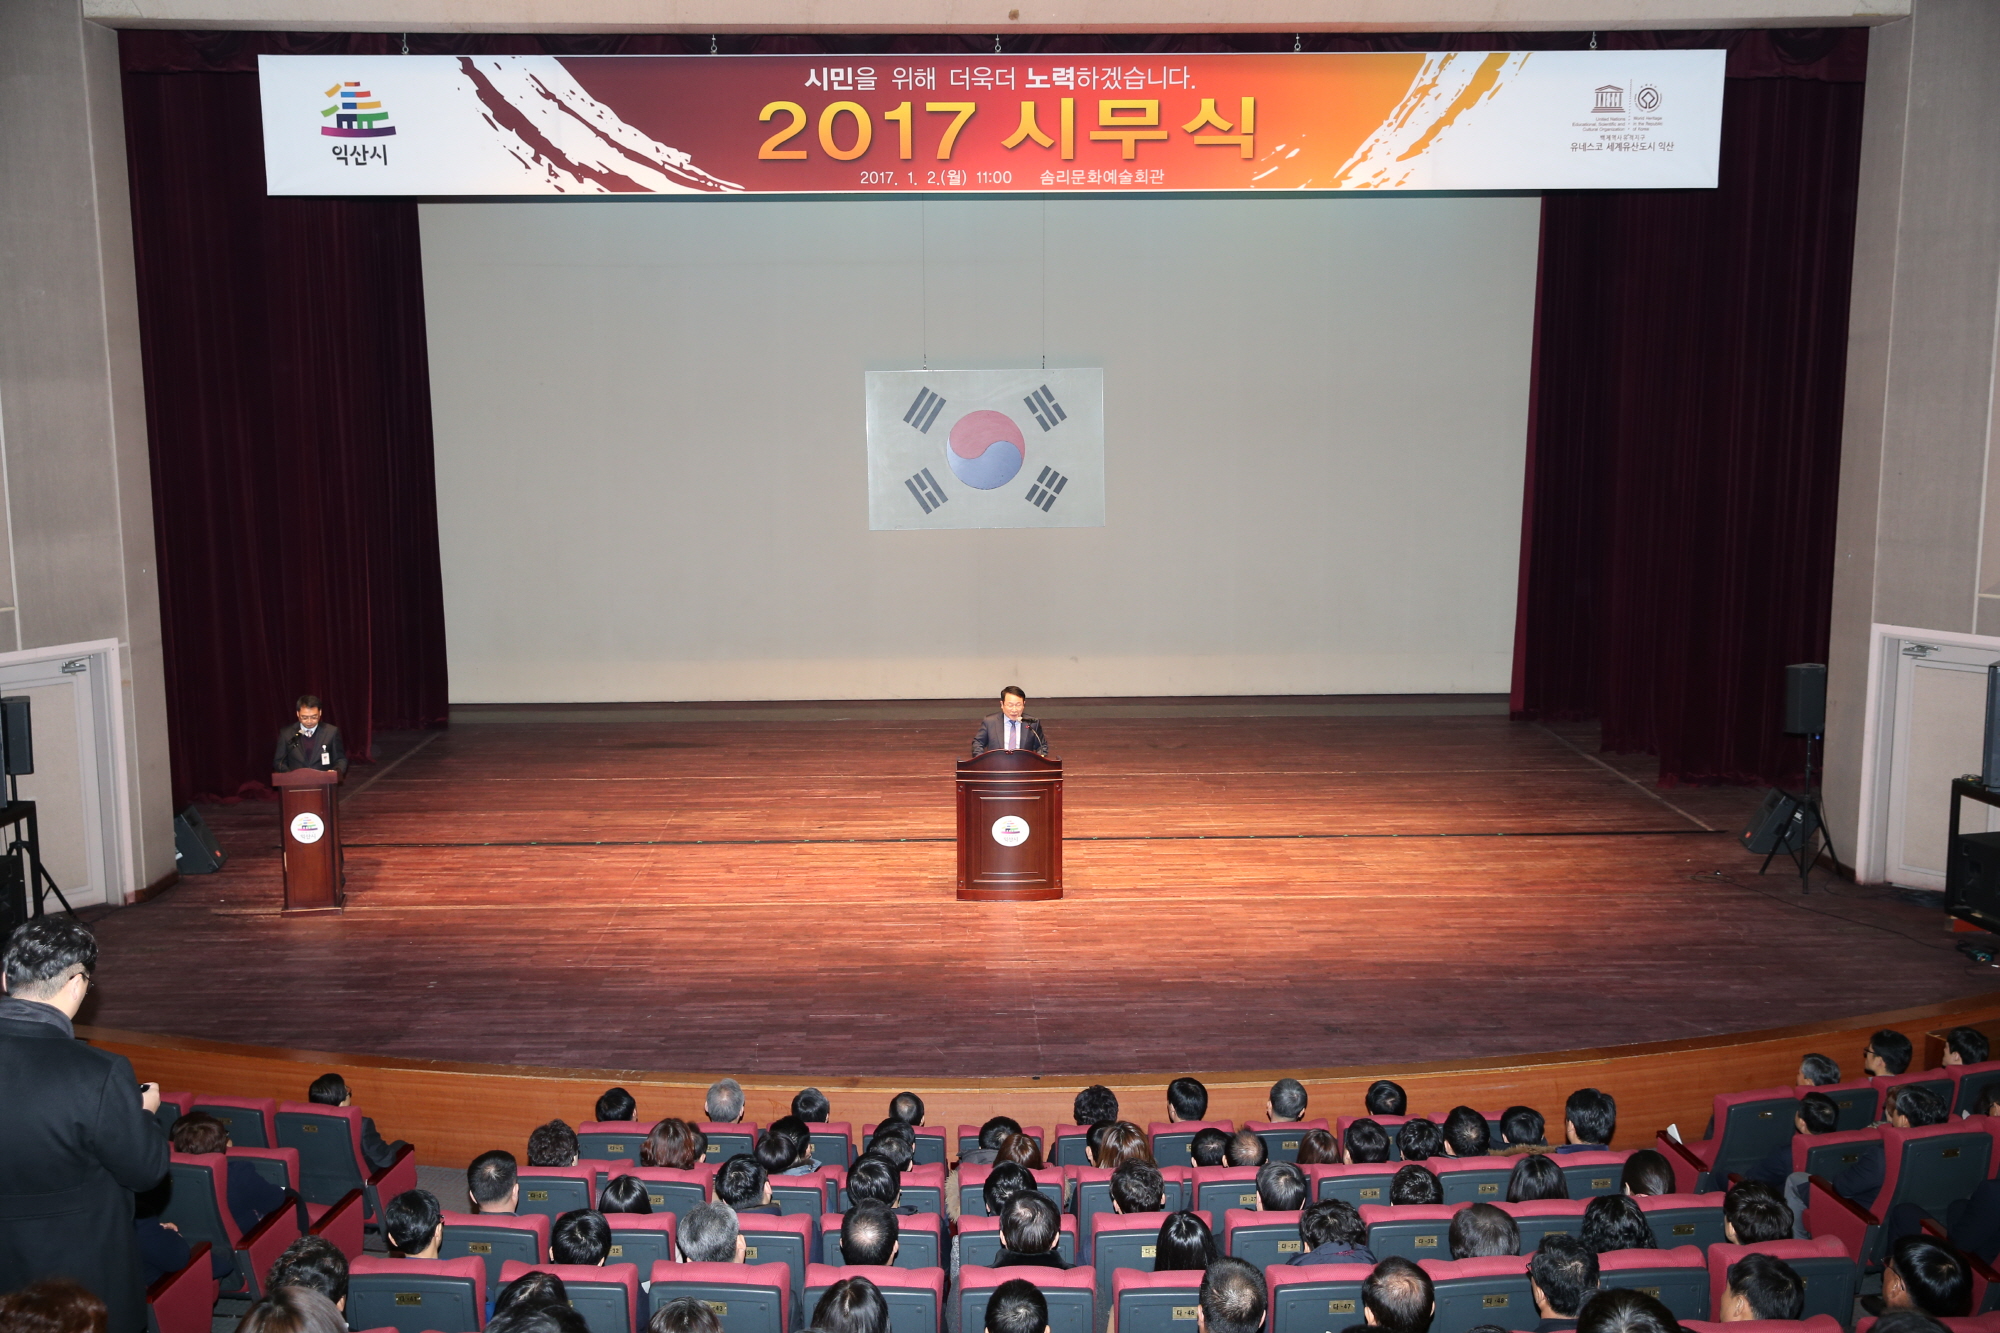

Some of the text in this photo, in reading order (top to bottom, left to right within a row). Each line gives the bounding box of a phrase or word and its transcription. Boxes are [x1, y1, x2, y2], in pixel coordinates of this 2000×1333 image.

[804, 65, 1197, 91] 시민을 위해 더욱더 노력하겠습니다.
[757, 96, 1257, 162] 2017 시무식
[332, 144, 388, 166] 익산시
[1570, 142, 1675, 152] 유네스코 세계유산도시 익산
[860, 168, 1165, 187] 2017. 1. 2.(월) 11:00 솜리문화예술회관
